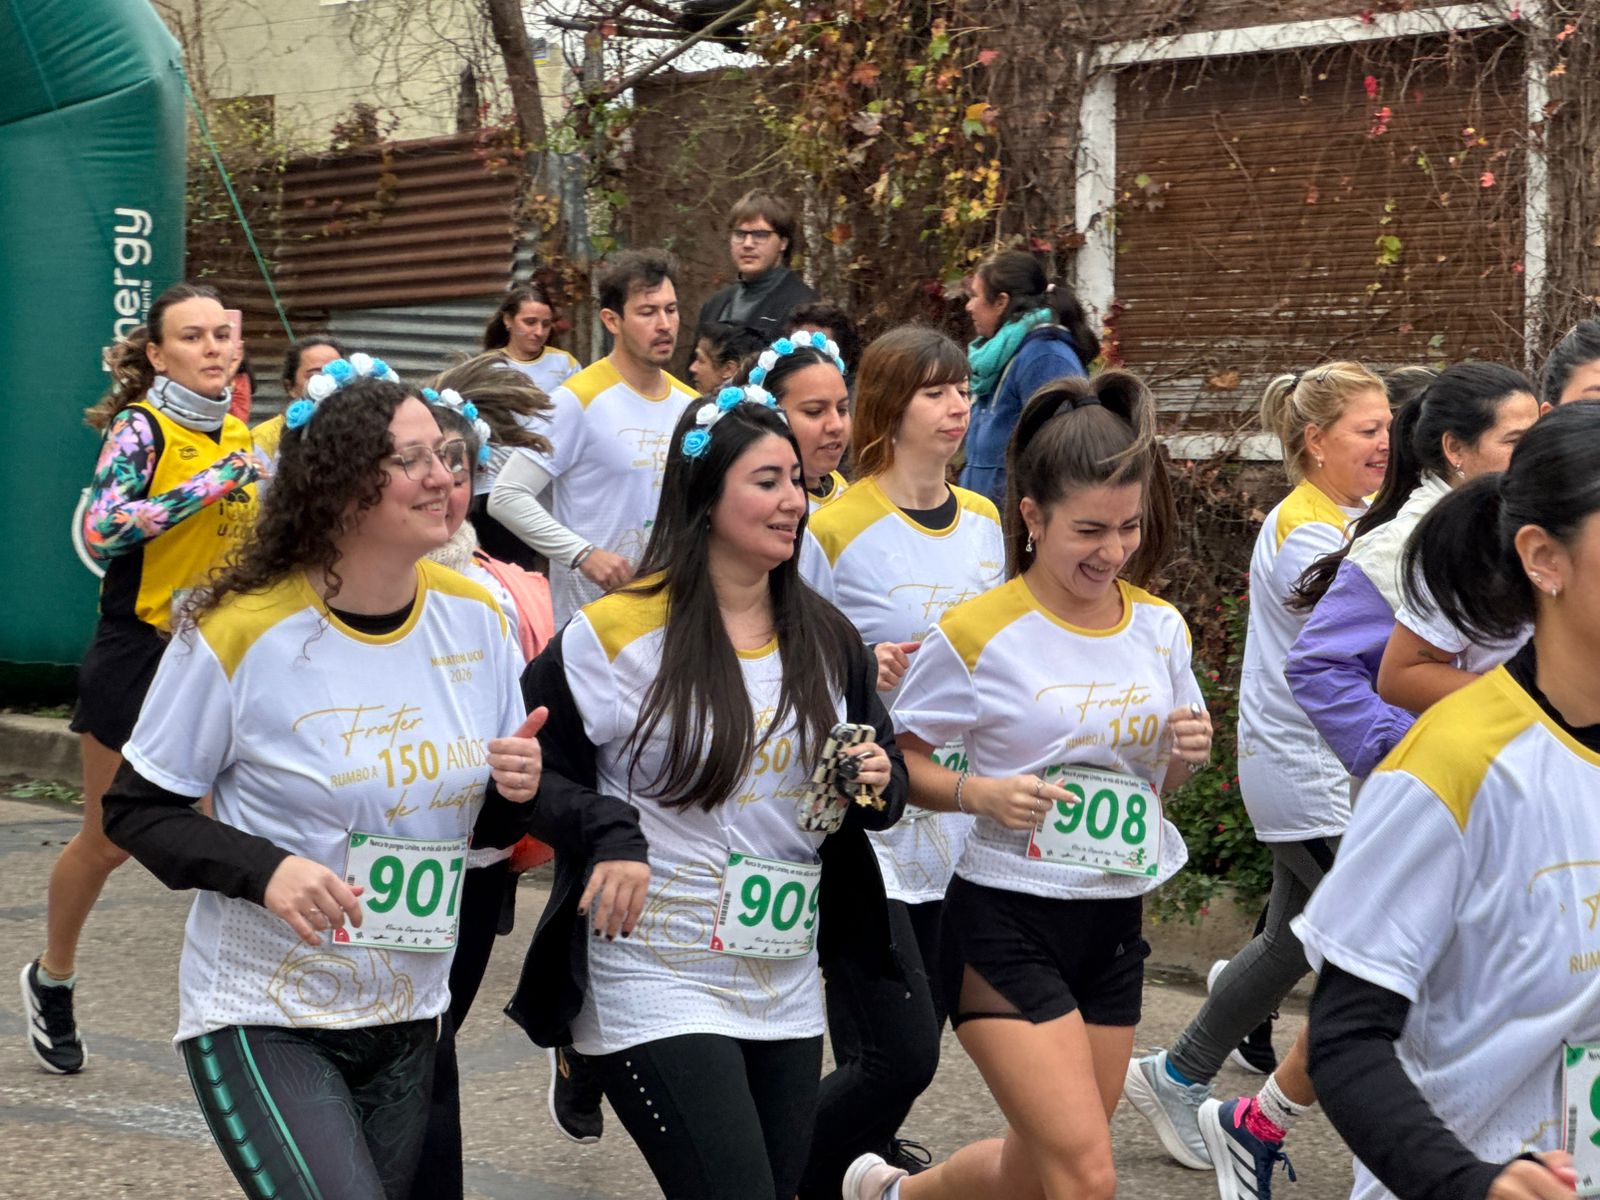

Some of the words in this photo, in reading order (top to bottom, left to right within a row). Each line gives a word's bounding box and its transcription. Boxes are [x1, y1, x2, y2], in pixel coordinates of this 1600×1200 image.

[102, 207, 152, 372] nergy
[450, 668, 473, 683] 2026
[1035, 681, 1152, 723] Frater
[293, 704, 423, 756] Frater
[1109, 714, 1158, 750] 150
[330, 769, 370, 788] RUMBO
[371, 765, 378, 779] A
[378, 740, 439, 788] 150
[754, 737, 792, 776] 50
[384, 790, 419, 825] de
[1053, 783, 1147, 845] 908
[366, 855, 464, 917] 907
[1570, 950, 1600, 974] RUM
